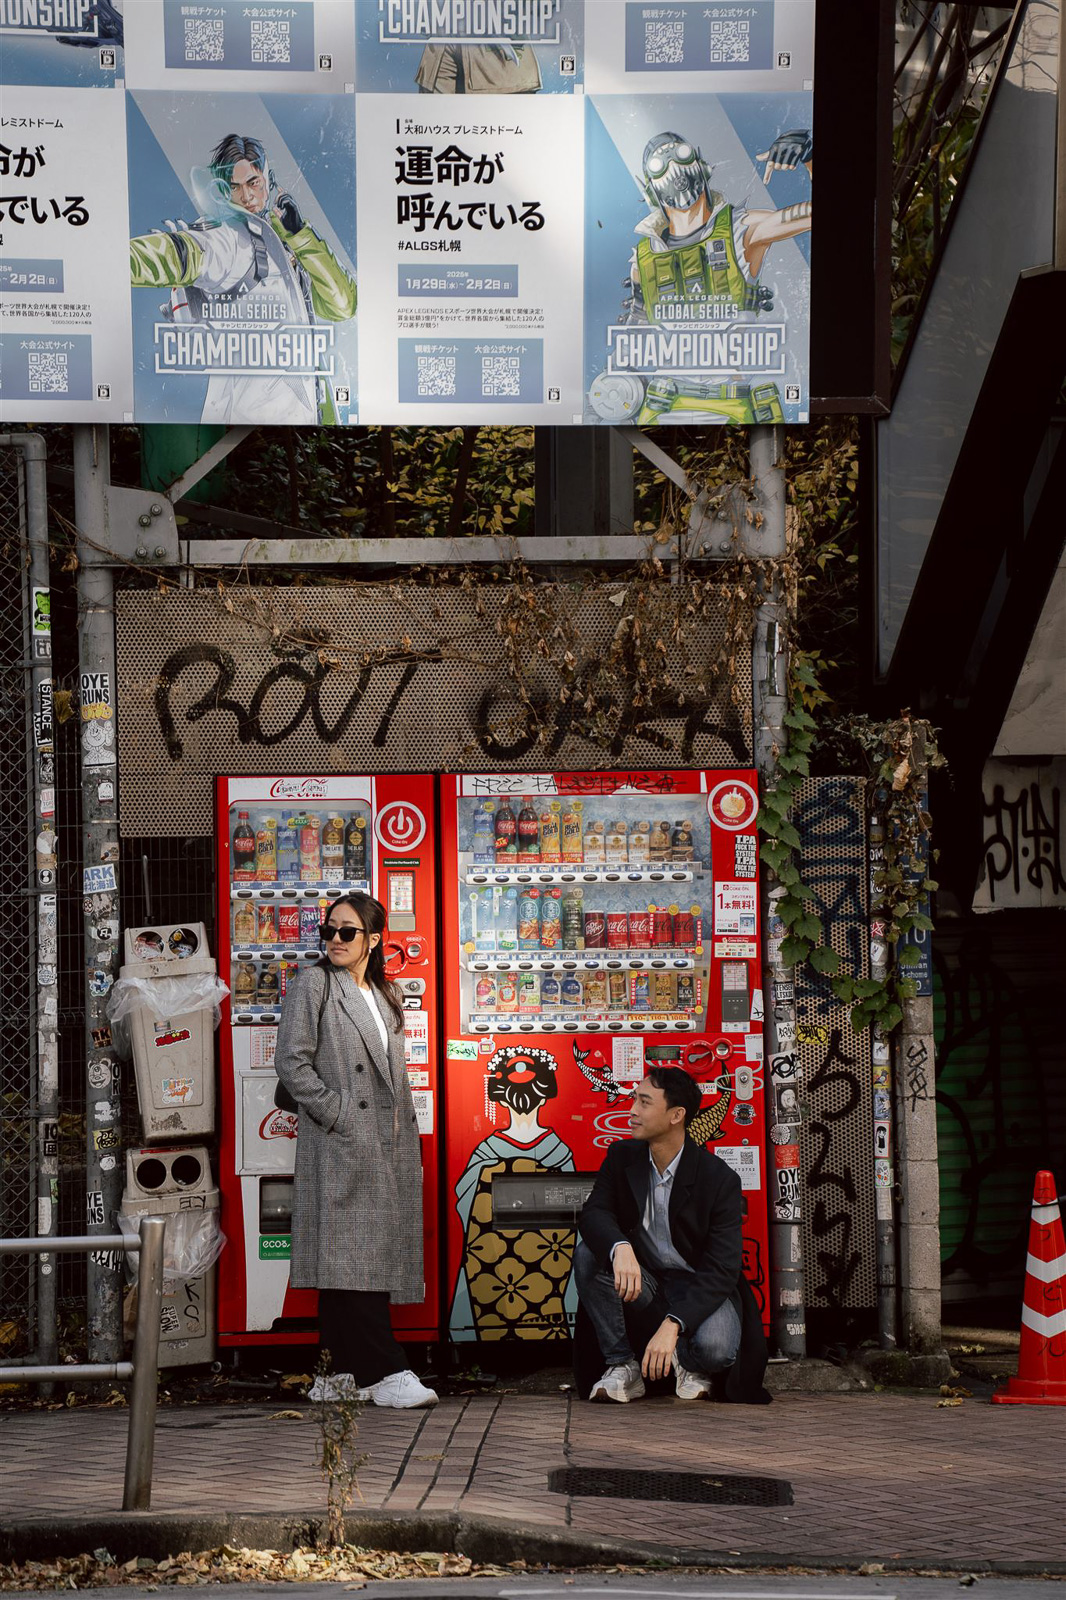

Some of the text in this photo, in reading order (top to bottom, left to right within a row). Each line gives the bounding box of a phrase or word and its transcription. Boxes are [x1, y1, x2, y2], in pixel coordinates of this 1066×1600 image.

[181, 7, 227, 16] 観戦チケット
[243, 8, 297, 17] 大会公式サイト
[642, 9, 687, 18] 観戦チケット
[703, 8, 758, 18] 大会公式サイト
[388, 0, 553, 35] CHAMPIONSHIP
[103, 56, 112, 65] D
[321, 59, 330, 69] D
[564, 61, 573, 71] D
[780, 56, 789, 68] D
[1, 118, 64, 128] レミストドーム
[404, 125, 523, 136] 大和ハウス プレミストドーム
[395, 145, 504, 187] 運命が
[0, 196, 90, 226] でいる
[397, 193, 545, 231] 呼んでいる
[397, 240, 462, 253] #ALGS札幌
[202, 302, 287, 320] GLOBAL SERIES
[654, 302, 739, 320] GLOBAL SERIES
[20, 340, 75, 350] 大会公式サイト
[163, 331, 327, 368] CHAMPIONSHIP
[414, 345, 459, 354] 観戦チケット
[474, 345, 527, 354] 大会公式サイト
[615, 332, 779, 368] CHAMPIONSHIP
[100, 389, 108, 397] D
[338, 391, 347, 401] D
[550, 391, 559, 400] D
[788, 389, 797, 401] D
[82, 674, 109, 689] OYE
[82, 689, 110, 705] RUNS
[41, 685, 51, 730] STANCE
[716, 892, 755, 910] 1本無料!
